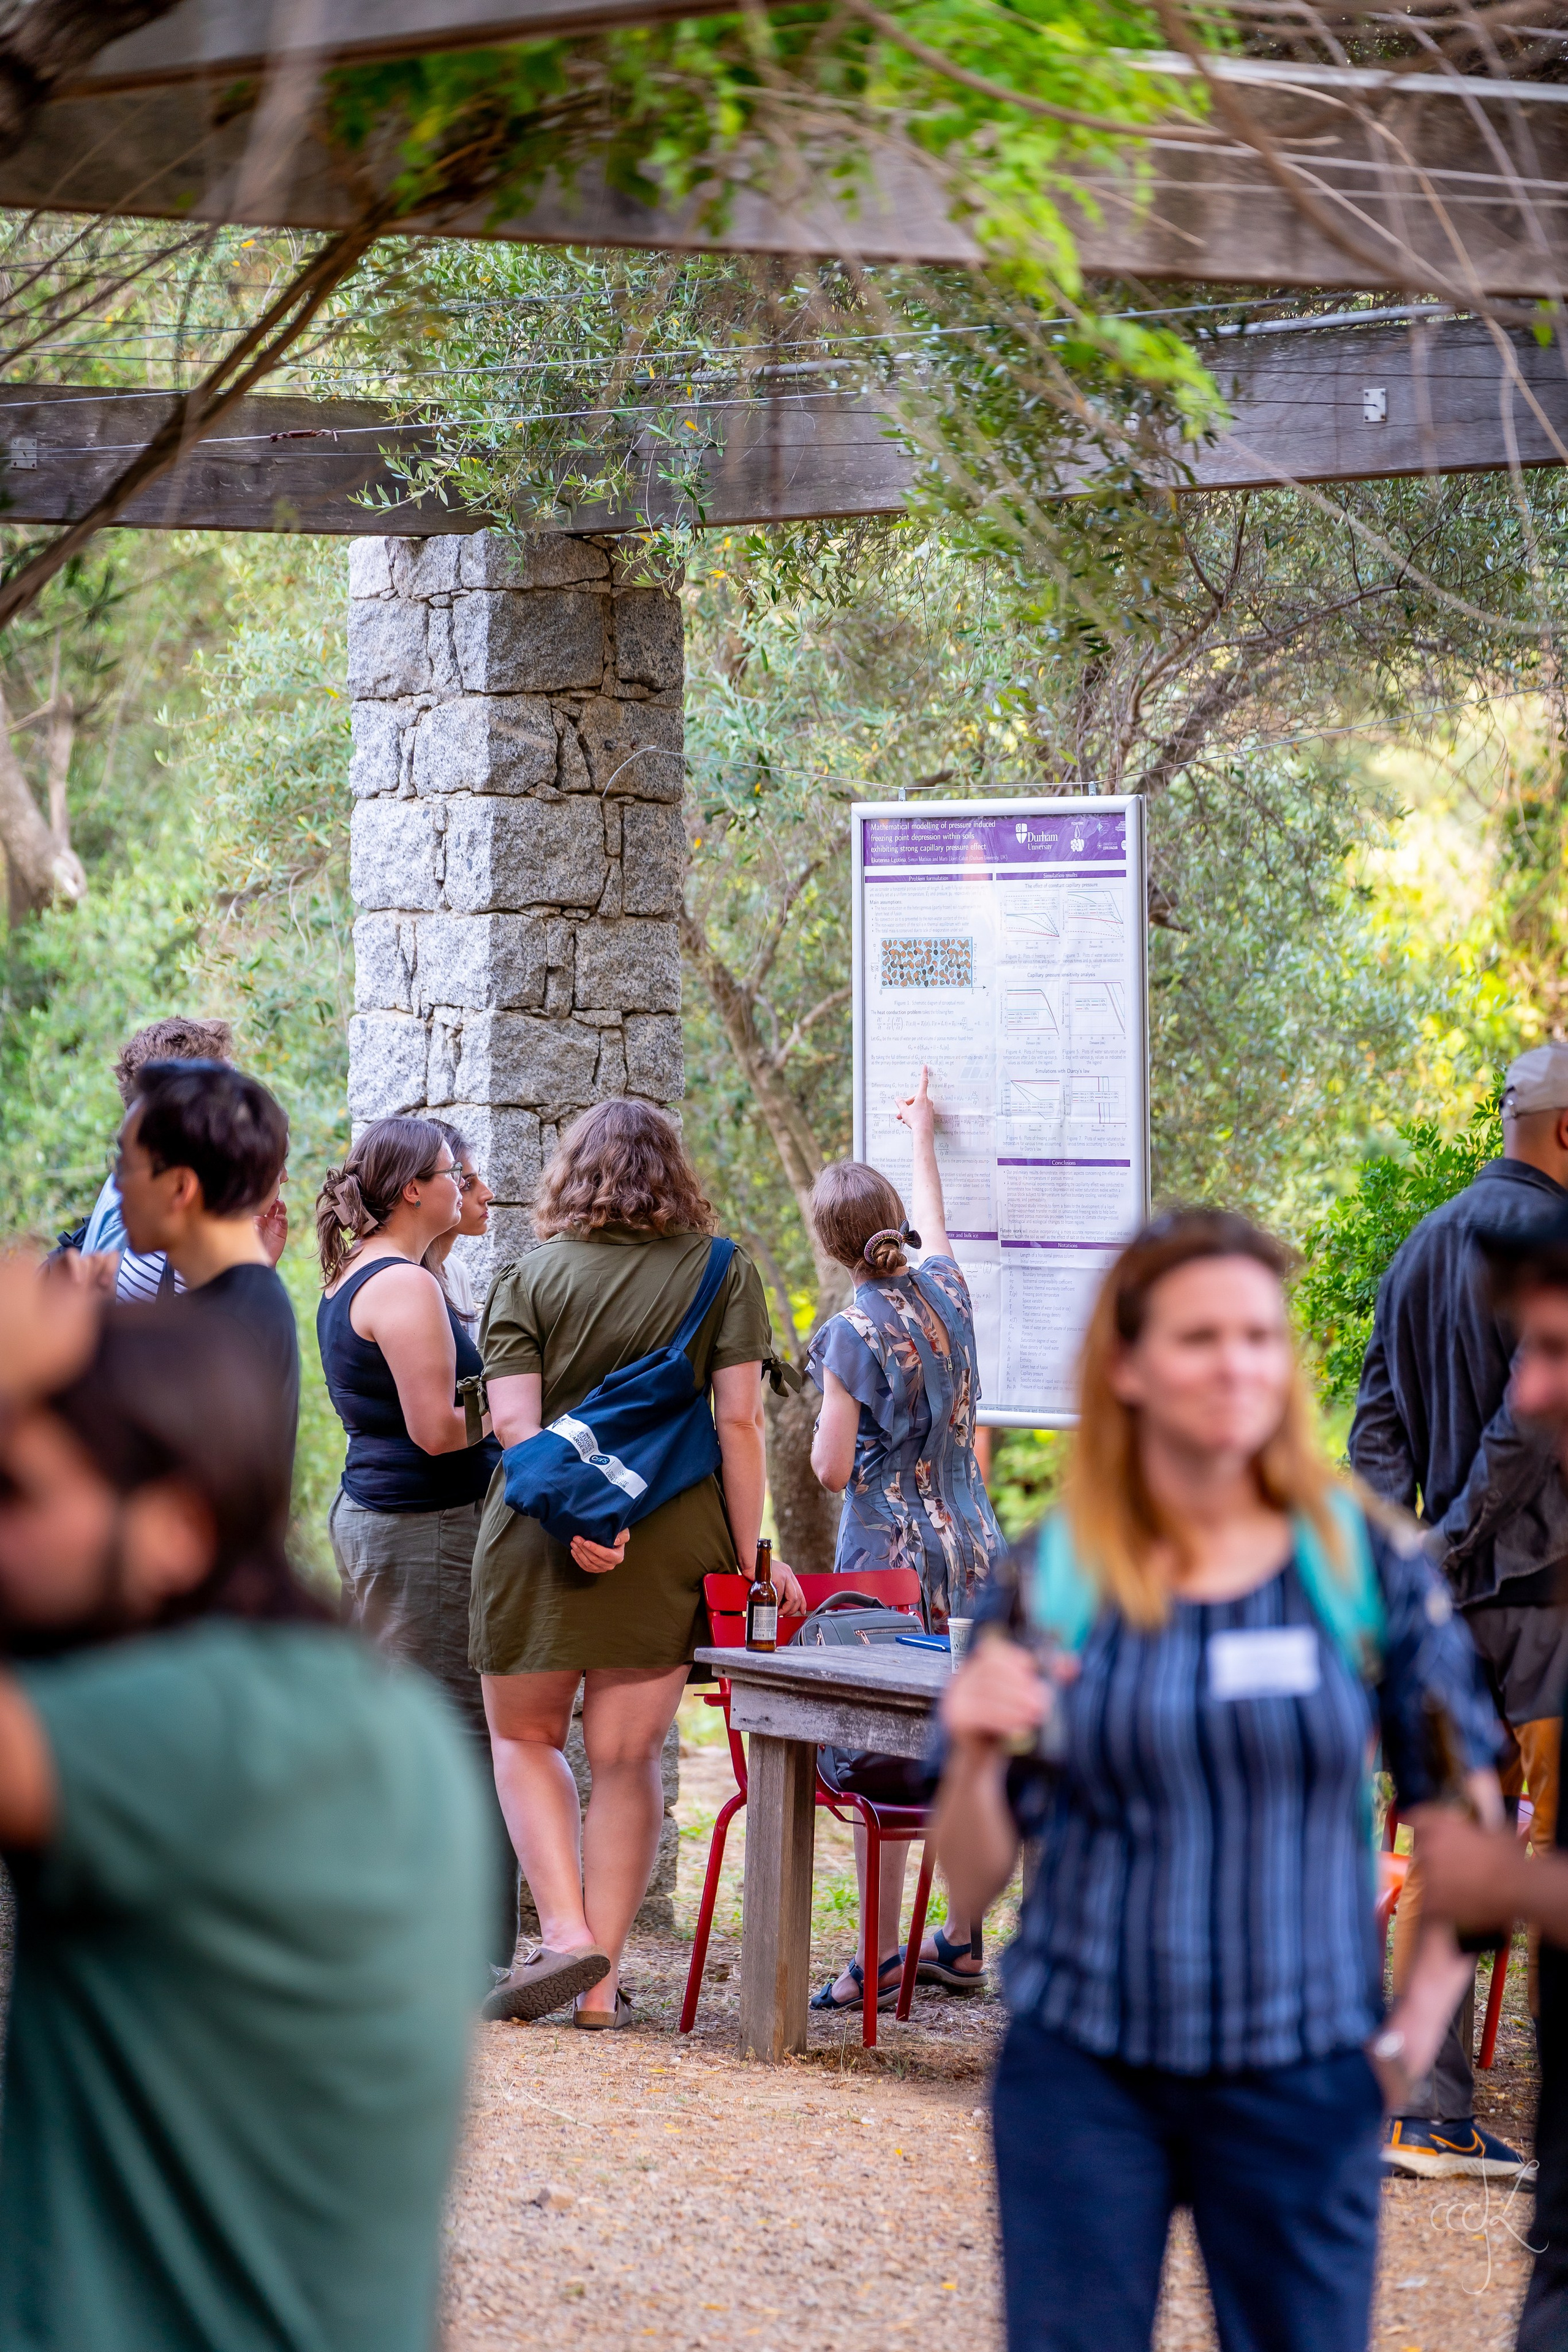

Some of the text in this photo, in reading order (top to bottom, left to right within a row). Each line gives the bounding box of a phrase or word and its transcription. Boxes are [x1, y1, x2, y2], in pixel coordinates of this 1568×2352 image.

[1028, 831, 1058, 842] Durham
[871, 845, 898, 853] exhibiting
[920, 844, 943, 853] capillary
